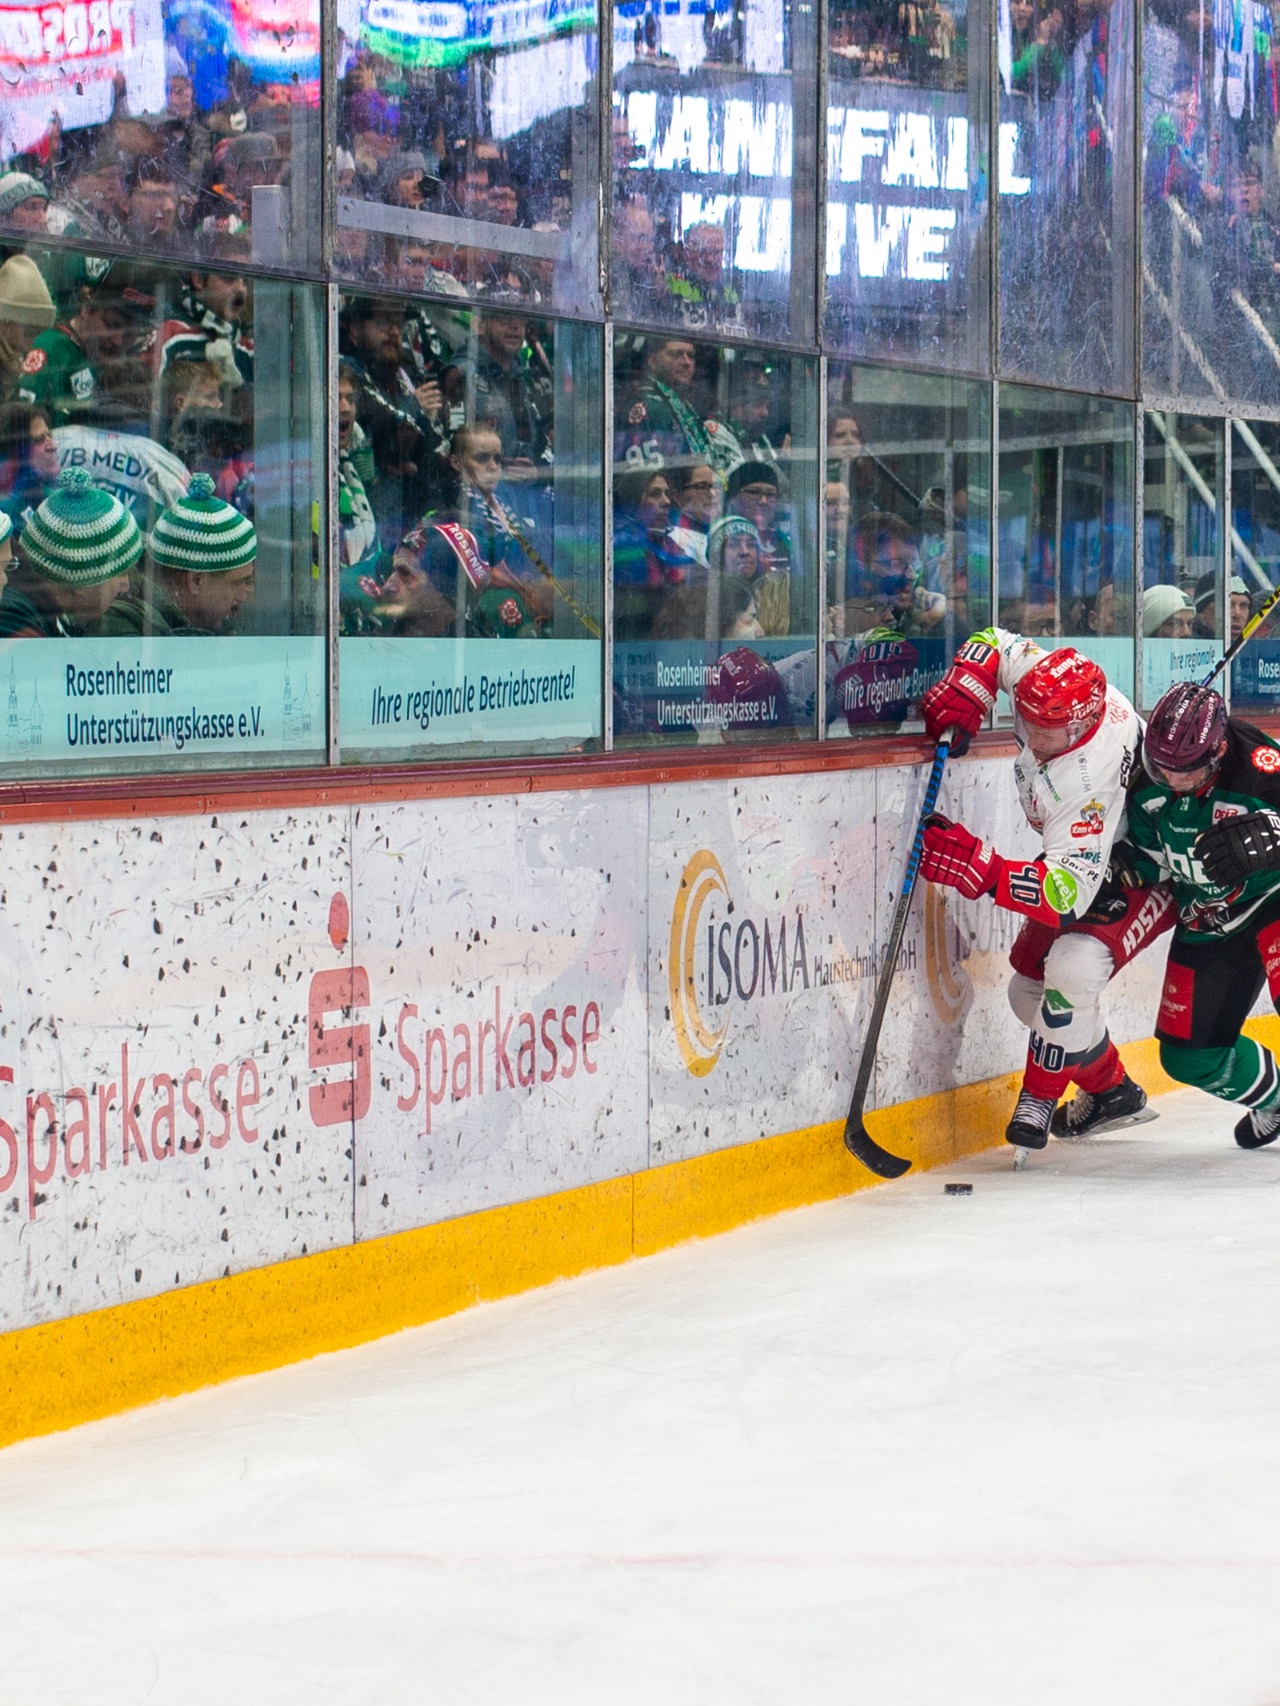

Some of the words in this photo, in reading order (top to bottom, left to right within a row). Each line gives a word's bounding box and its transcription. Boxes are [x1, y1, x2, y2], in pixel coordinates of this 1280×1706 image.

[92, 450, 161, 491] MEDIA
[625, 440, 664, 472] 95
[66, 661, 172, 696] Rosenheimer
[657, 660, 721, 687] Rosenheimer
[371, 686, 402, 726] Ihre
[406, 676, 475, 731] regionale
[479, 665, 576, 712] Betriebsrente!
[657, 698, 758, 730] Unterstützungskasse
[761, 696, 778, 721] e.V.
[844, 679, 865, 711] Ihre
[67, 708, 234, 750] Unterstützungskasse
[238, 706, 265, 737] e.V.
[1009, 865, 1041, 906] 40
[707, 914, 810, 1006] ISOMA
[397, 987, 601, 1136] Sparkasse
[1029, 1030, 1064, 1072] 40
[0, 1044, 260, 1220] Sparkasse
